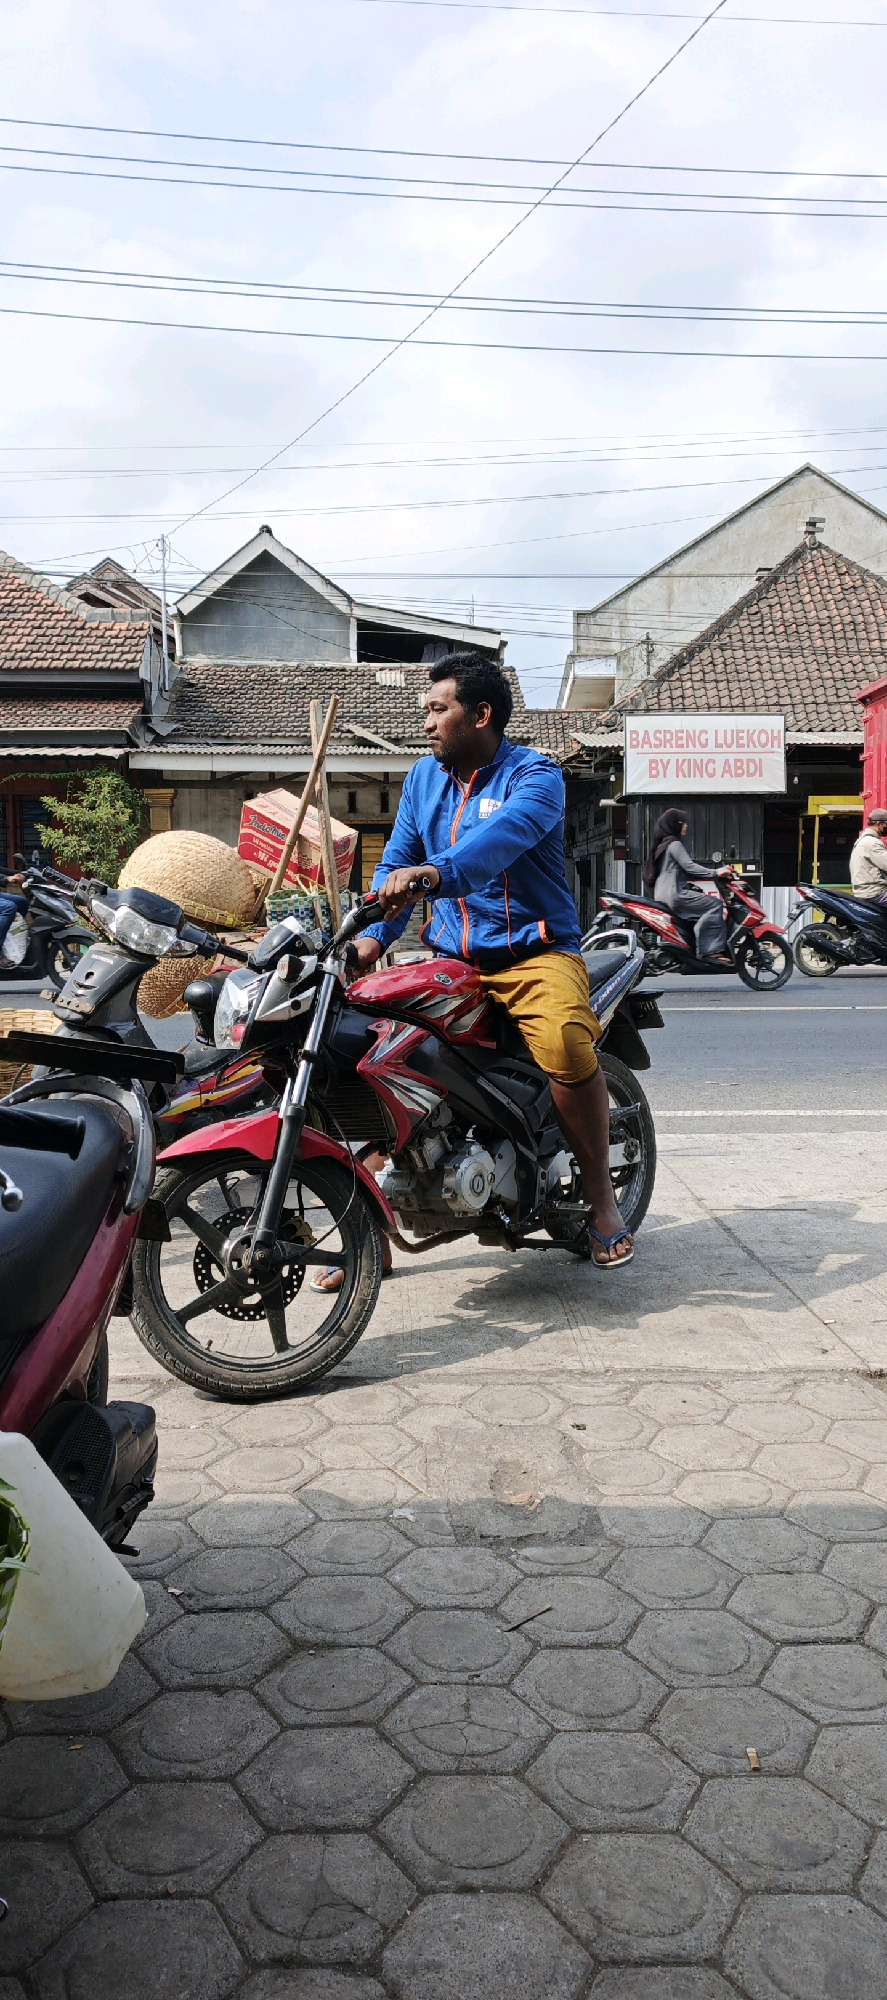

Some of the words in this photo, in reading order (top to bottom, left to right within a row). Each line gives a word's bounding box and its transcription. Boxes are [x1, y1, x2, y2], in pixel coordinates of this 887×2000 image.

[629, 729, 709, 750] BASRENG
[714, 729, 782, 749] LUEKOH
[648, 758, 671, 779] BY
[675, 758, 717, 778] KING
[721, 758, 764, 778] ABDI
